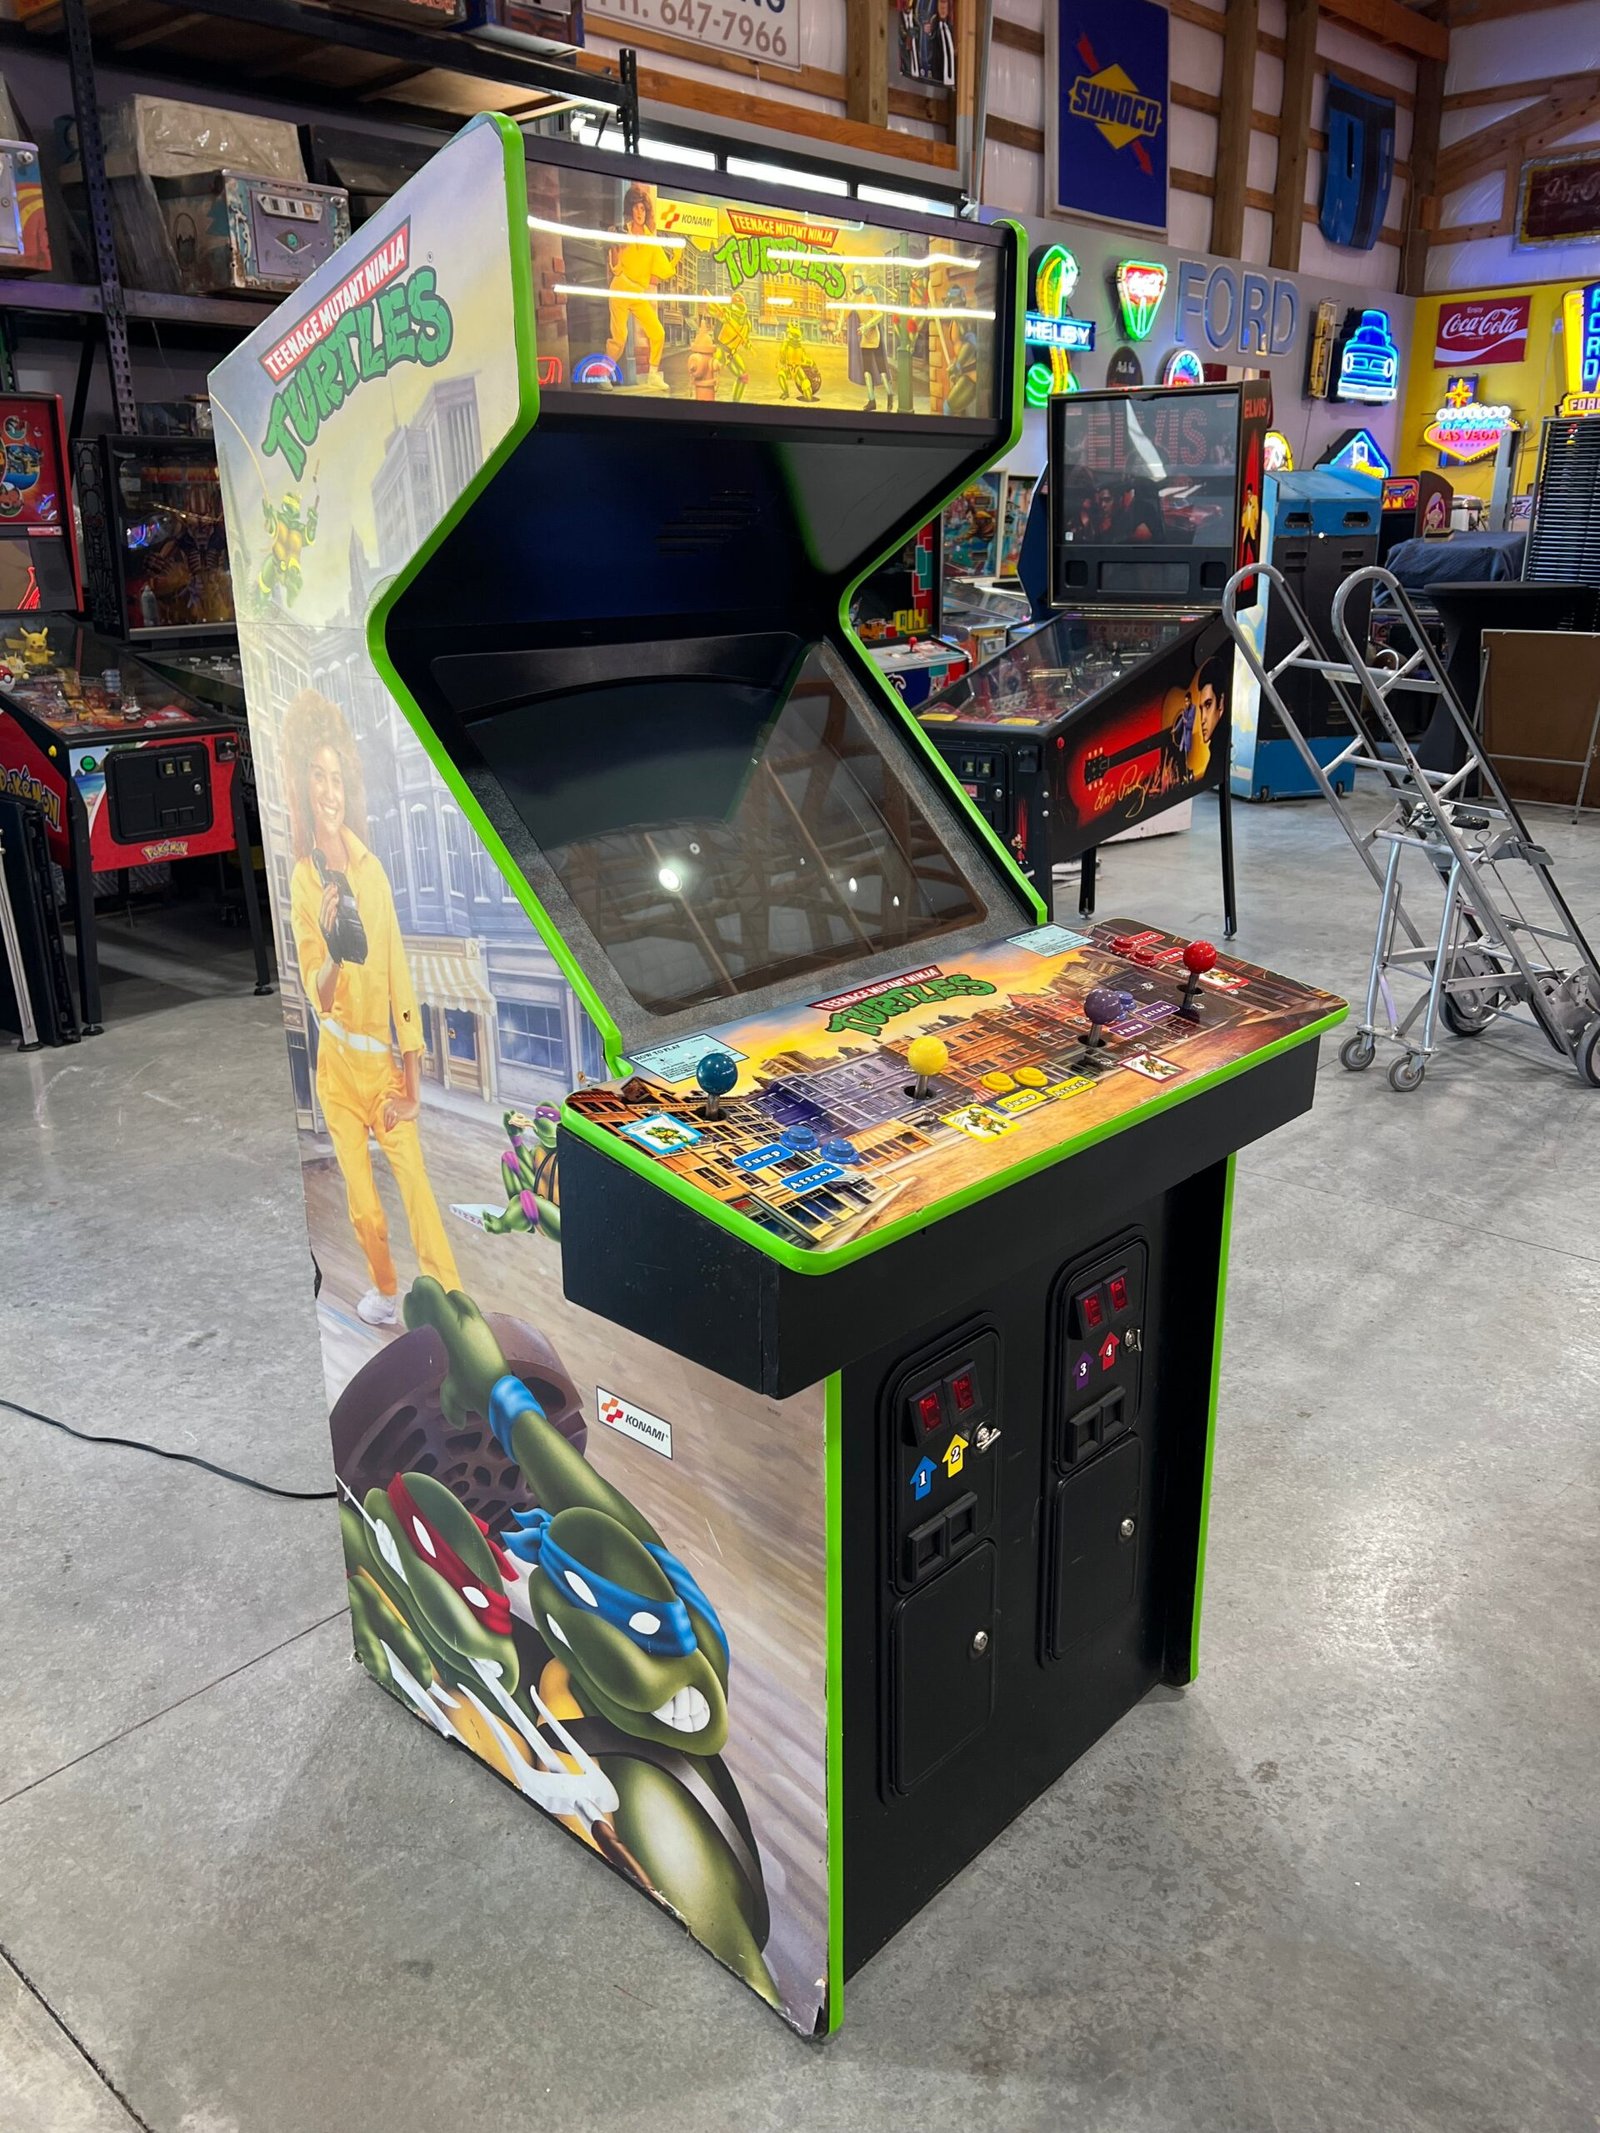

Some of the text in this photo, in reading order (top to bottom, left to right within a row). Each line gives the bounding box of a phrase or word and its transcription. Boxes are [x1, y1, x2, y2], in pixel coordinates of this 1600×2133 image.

[660, 0, 787, 57] 647-7966
[1071, 78, 1161, 134] SUNOCO
[681, 213, 713, 228] KONAMI
[731, 214, 834, 244] TEENAGE MUTANT NINJA
[712, 235, 847, 300] TURTLES
[263, 233, 406, 377] TEENAGE MUTANT NINJA
[1174, 258, 1300, 358] FORD
[1026, 319, 1091, 346] HELBY
[1442, 306, 1524, 339] Coca-Cola
[261, 265, 454, 483] TURTLES
[1244, 398, 1268, 420] ELVIS
[1570, 398, 1600, 412] FOR
[1437, 430, 1500, 442] LAS VEGA
[894, 608, 929, 635] QIX
[815, 967, 940, 1011] TEENAGE MUTANT NINJA
[824, 973, 998, 1037] TURTLES
[1141, 1003, 1173, 1019] Attack
[1116, 1022, 1145, 1036] Jump
[1052, 1078, 1090, 1098] Attack
[1006, 1093, 1039, 1110] Jump
[742, 1148, 783, 1169] Jump
[788, 1166, 838, 1190] Attack
[1105, 1343, 1113, 1358] 4
[1079, 1362, 1088, 1377] 3
[624, 1413, 666, 1443] KONAMI
[951, 1446, 960, 1463] 2
[919, 1470, 927, 1487] 1
